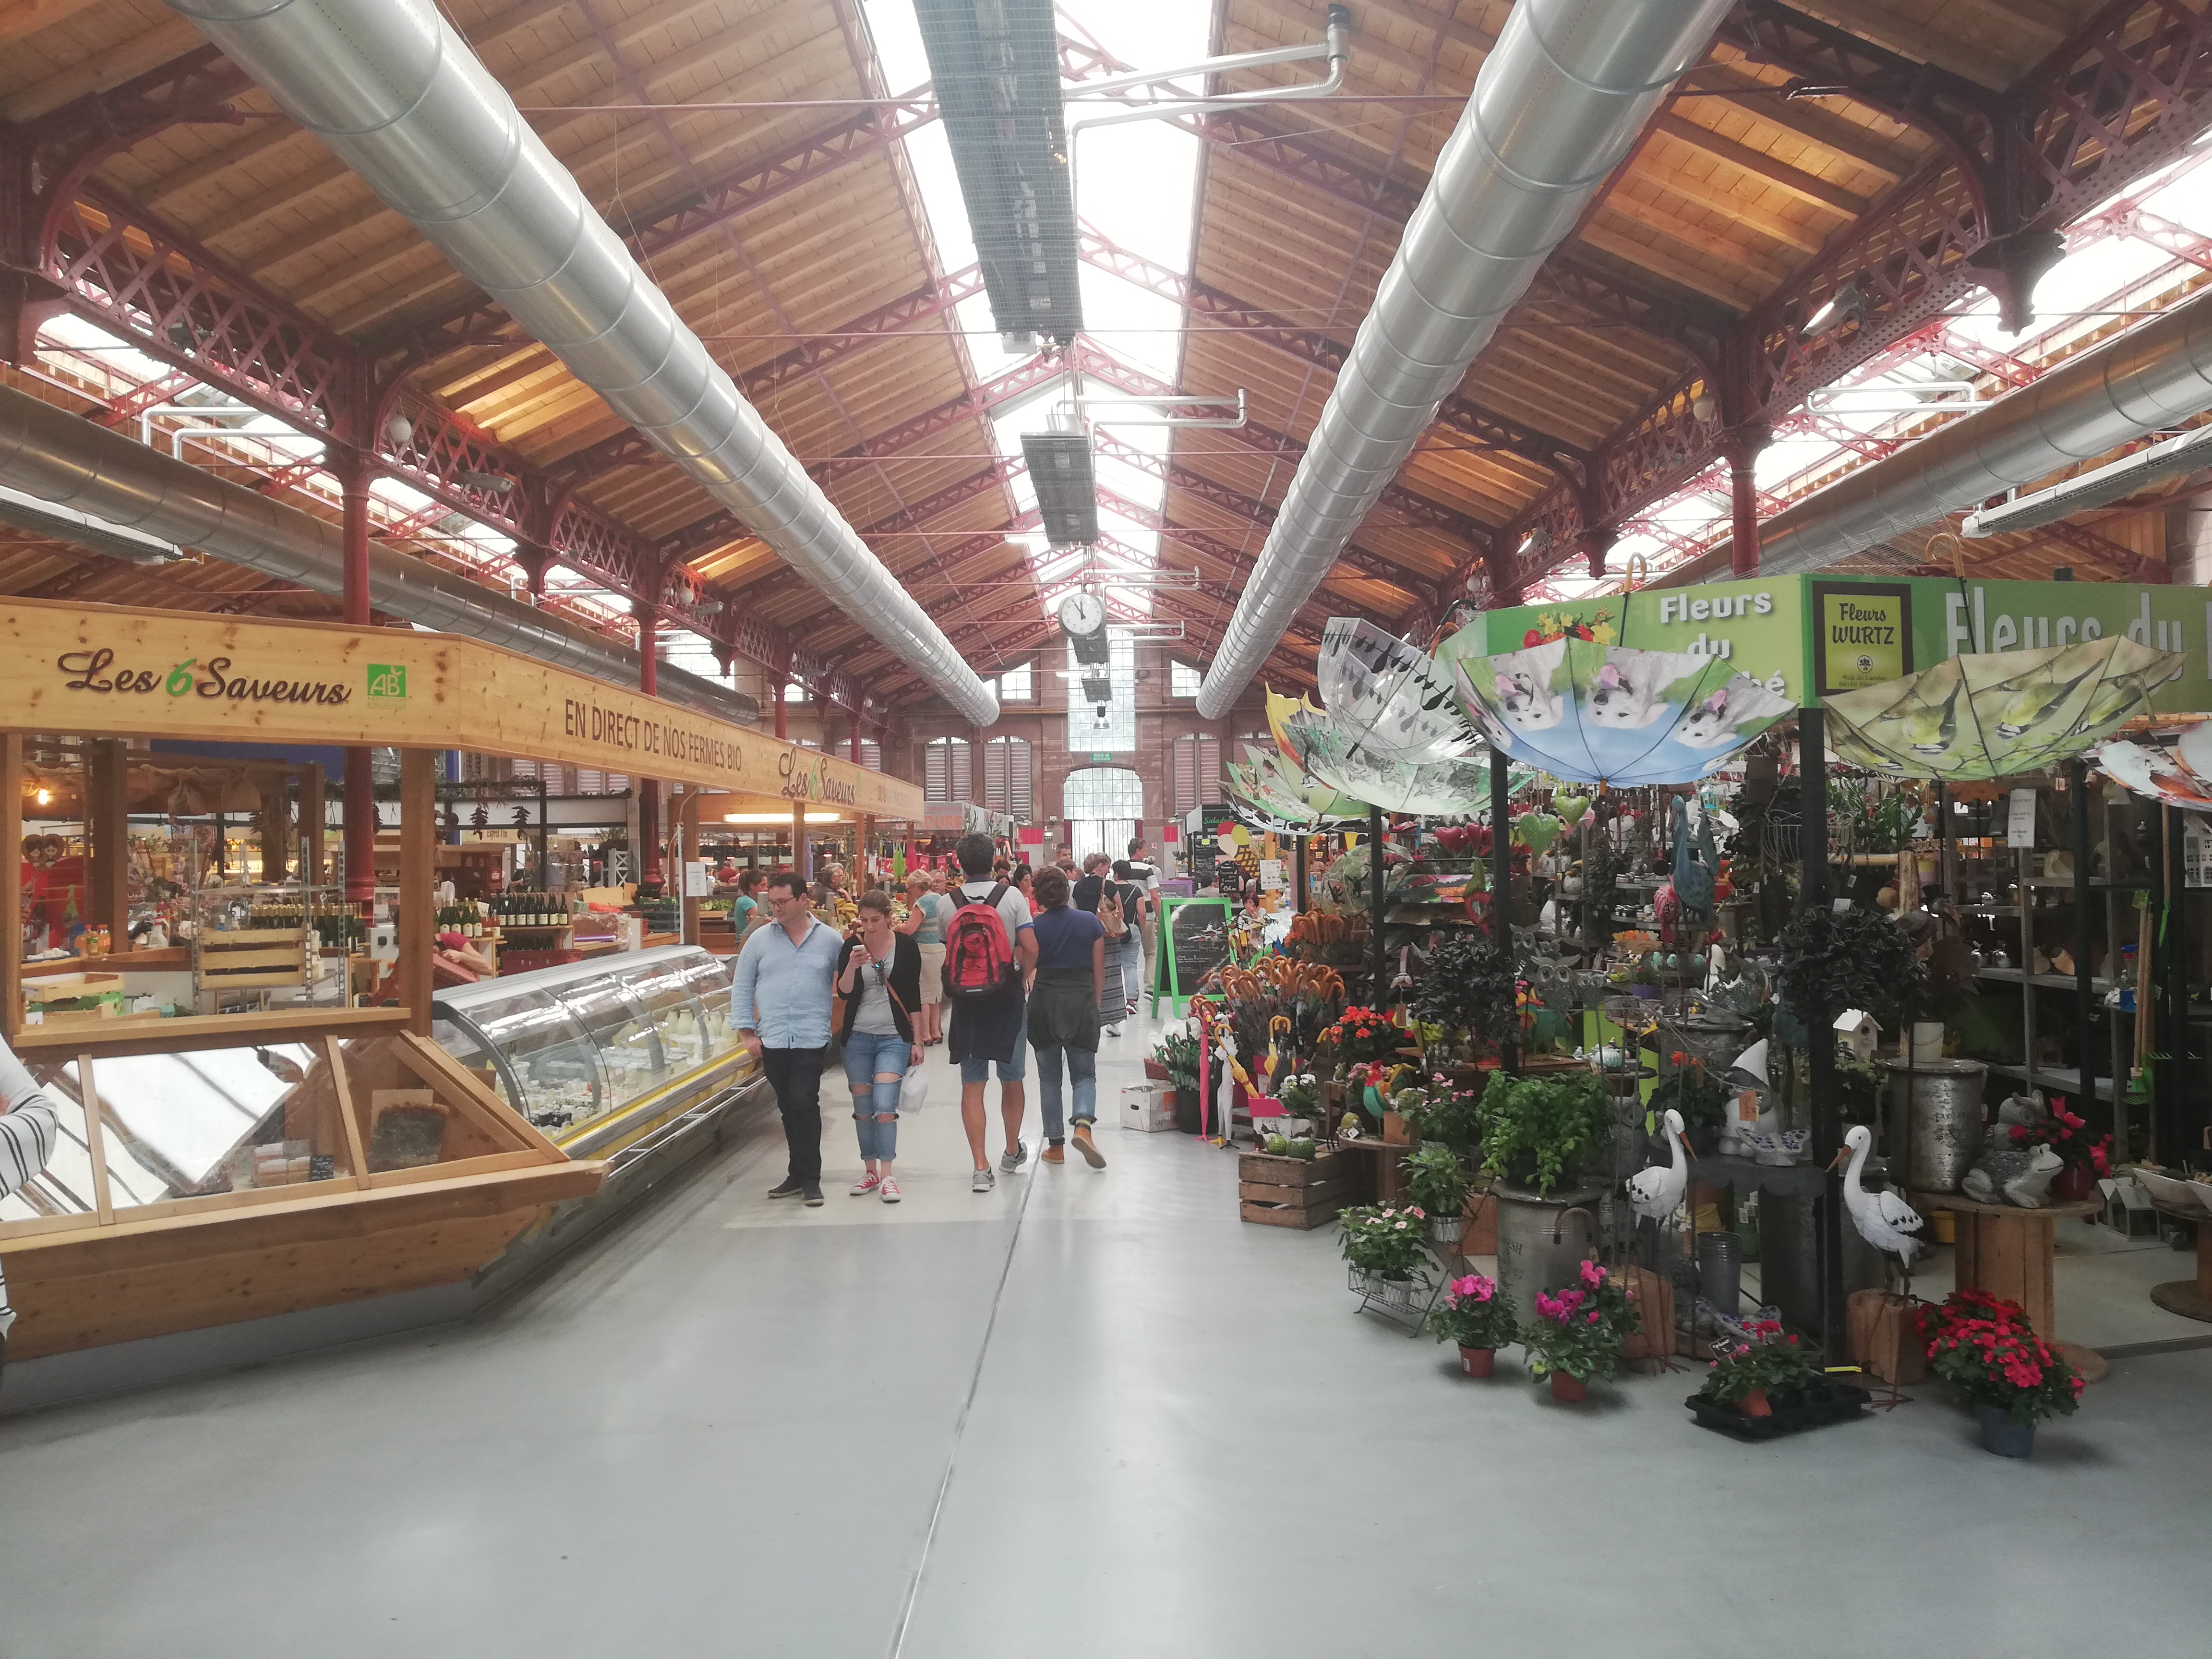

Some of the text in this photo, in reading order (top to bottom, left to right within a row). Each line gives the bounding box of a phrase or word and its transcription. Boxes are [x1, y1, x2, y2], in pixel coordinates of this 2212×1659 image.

[1660, 592, 1772, 623] Fleurs
[1839, 602, 1886, 622] Fleurs
[1687, 633, 1730, 659] du
[1832, 625, 1894, 645] WURTZ
[57, 647, 352, 706] Les 6 Saveurs
[370, 673, 400, 696] AB
[565, 698, 742, 772] EN DIRECT DE NOS FERMES BIO
[779, 746, 810, 799] Les
[809, 756, 818, 800] 6
[819, 757, 855, 806] Saveurs
